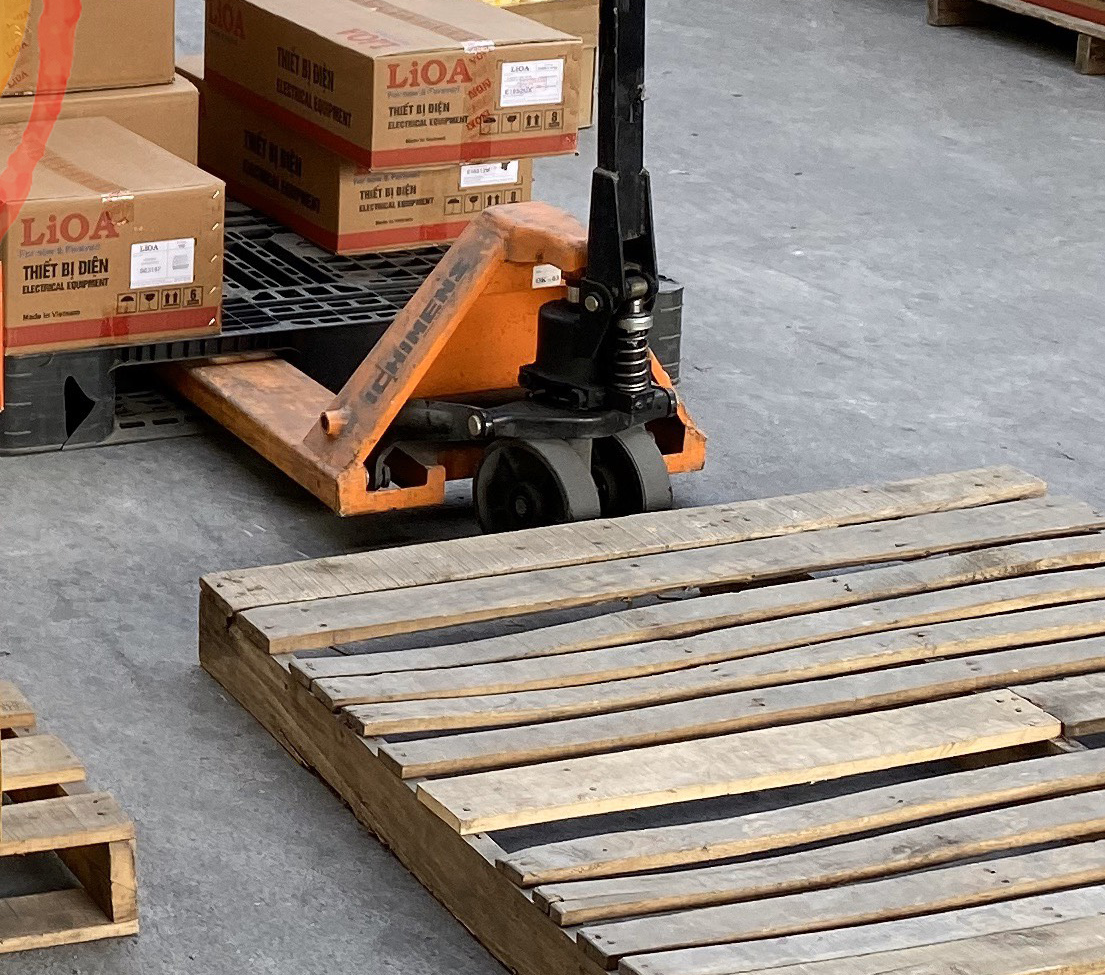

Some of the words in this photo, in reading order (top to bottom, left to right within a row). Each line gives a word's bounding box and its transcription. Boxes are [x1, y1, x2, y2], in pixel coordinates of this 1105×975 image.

[277, 46, 300, 76] THIẾT
[387, 58, 473, 89] LiOA
[389, 102, 414, 117] THIẾT
[428, 101, 449, 116] ĐIỆN
[388, 119, 427, 130] ELECTRICAL
[360, 184, 382, 200] THIẾT
[20, 210, 119, 247] LiOA
[23, 258, 58, 281] THIẾT
[61, 261, 74, 281] BỊ
[22, 283, 65, 294] ELECTRICAL
[67, 278, 109, 290] EQUIPMENT
